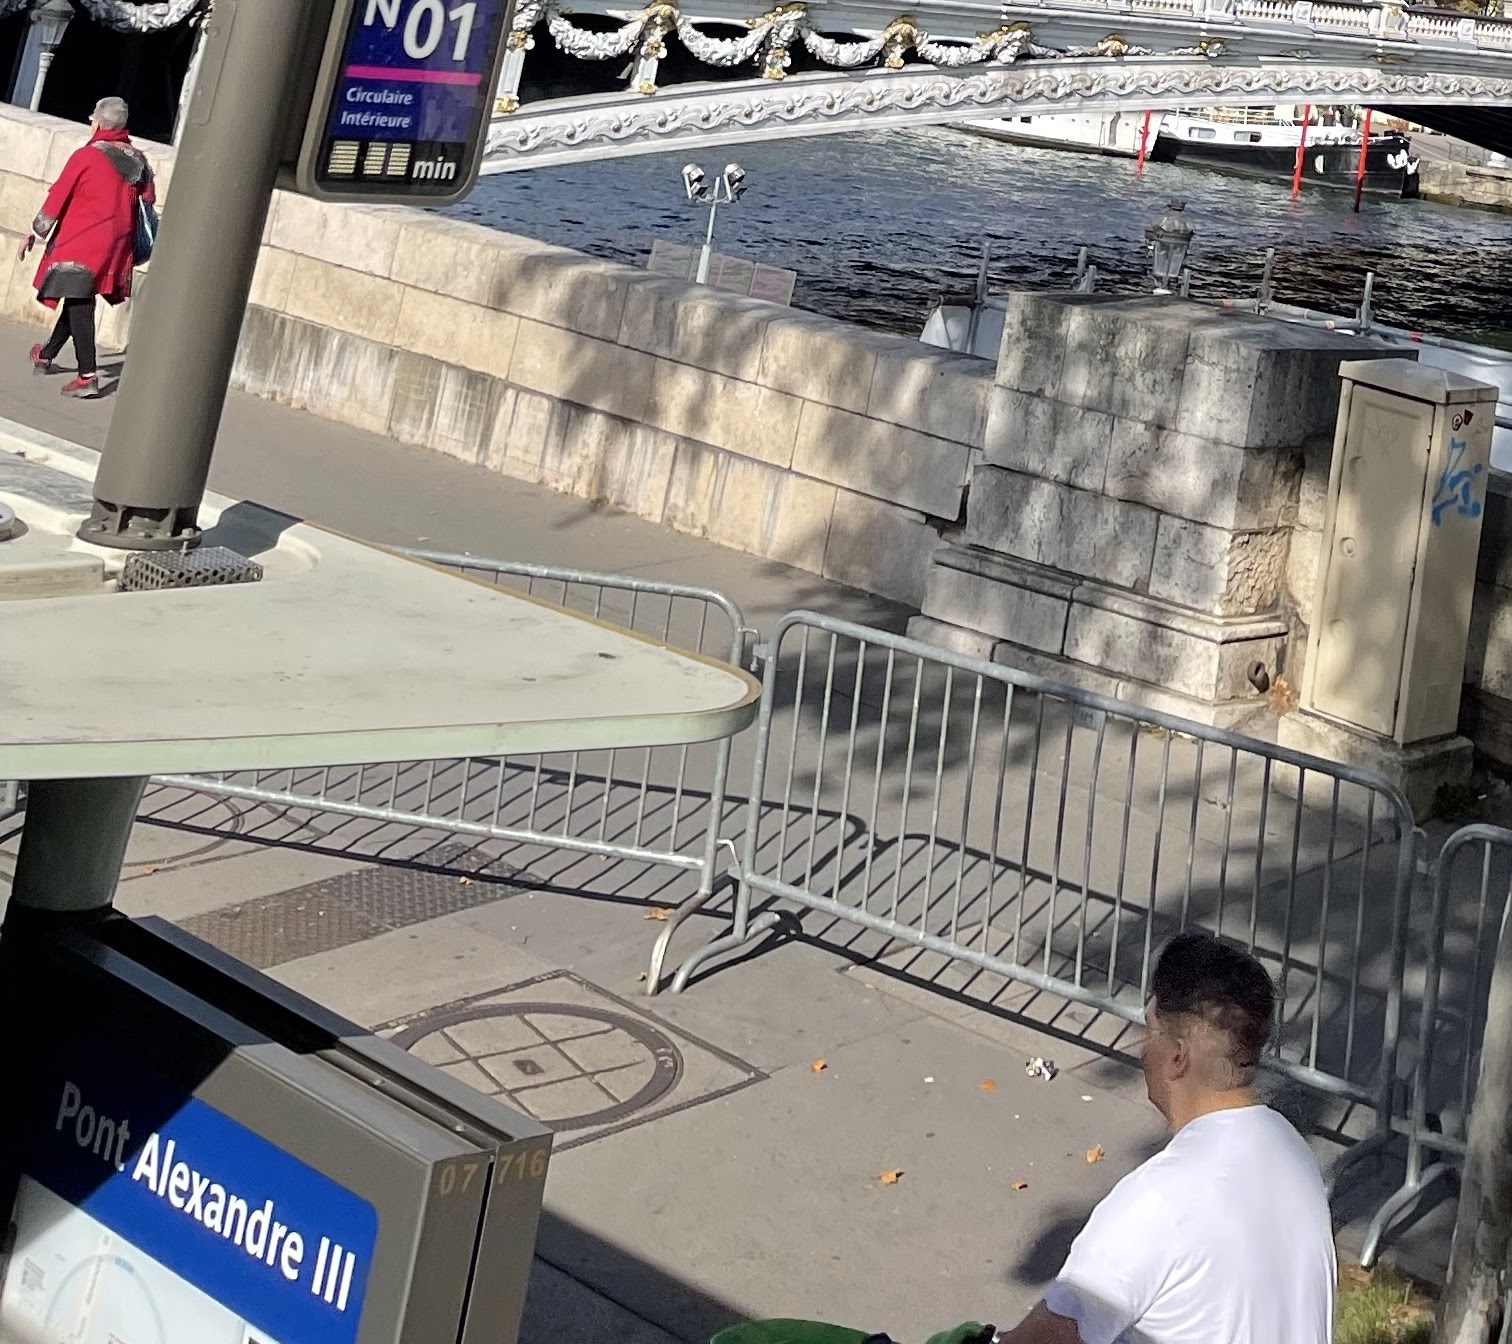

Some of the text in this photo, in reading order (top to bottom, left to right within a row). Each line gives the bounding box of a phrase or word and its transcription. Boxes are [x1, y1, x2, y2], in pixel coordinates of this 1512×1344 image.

[346, 86, 414, 106] Circulaire
[340, 110, 412, 129] Intérieure
[412, 155, 457, 180] min
[56, 1080, 130, 1172] Pont
[132, 1132, 304, 1281] Alexandre
[311, 1236, 356, 1312] III
